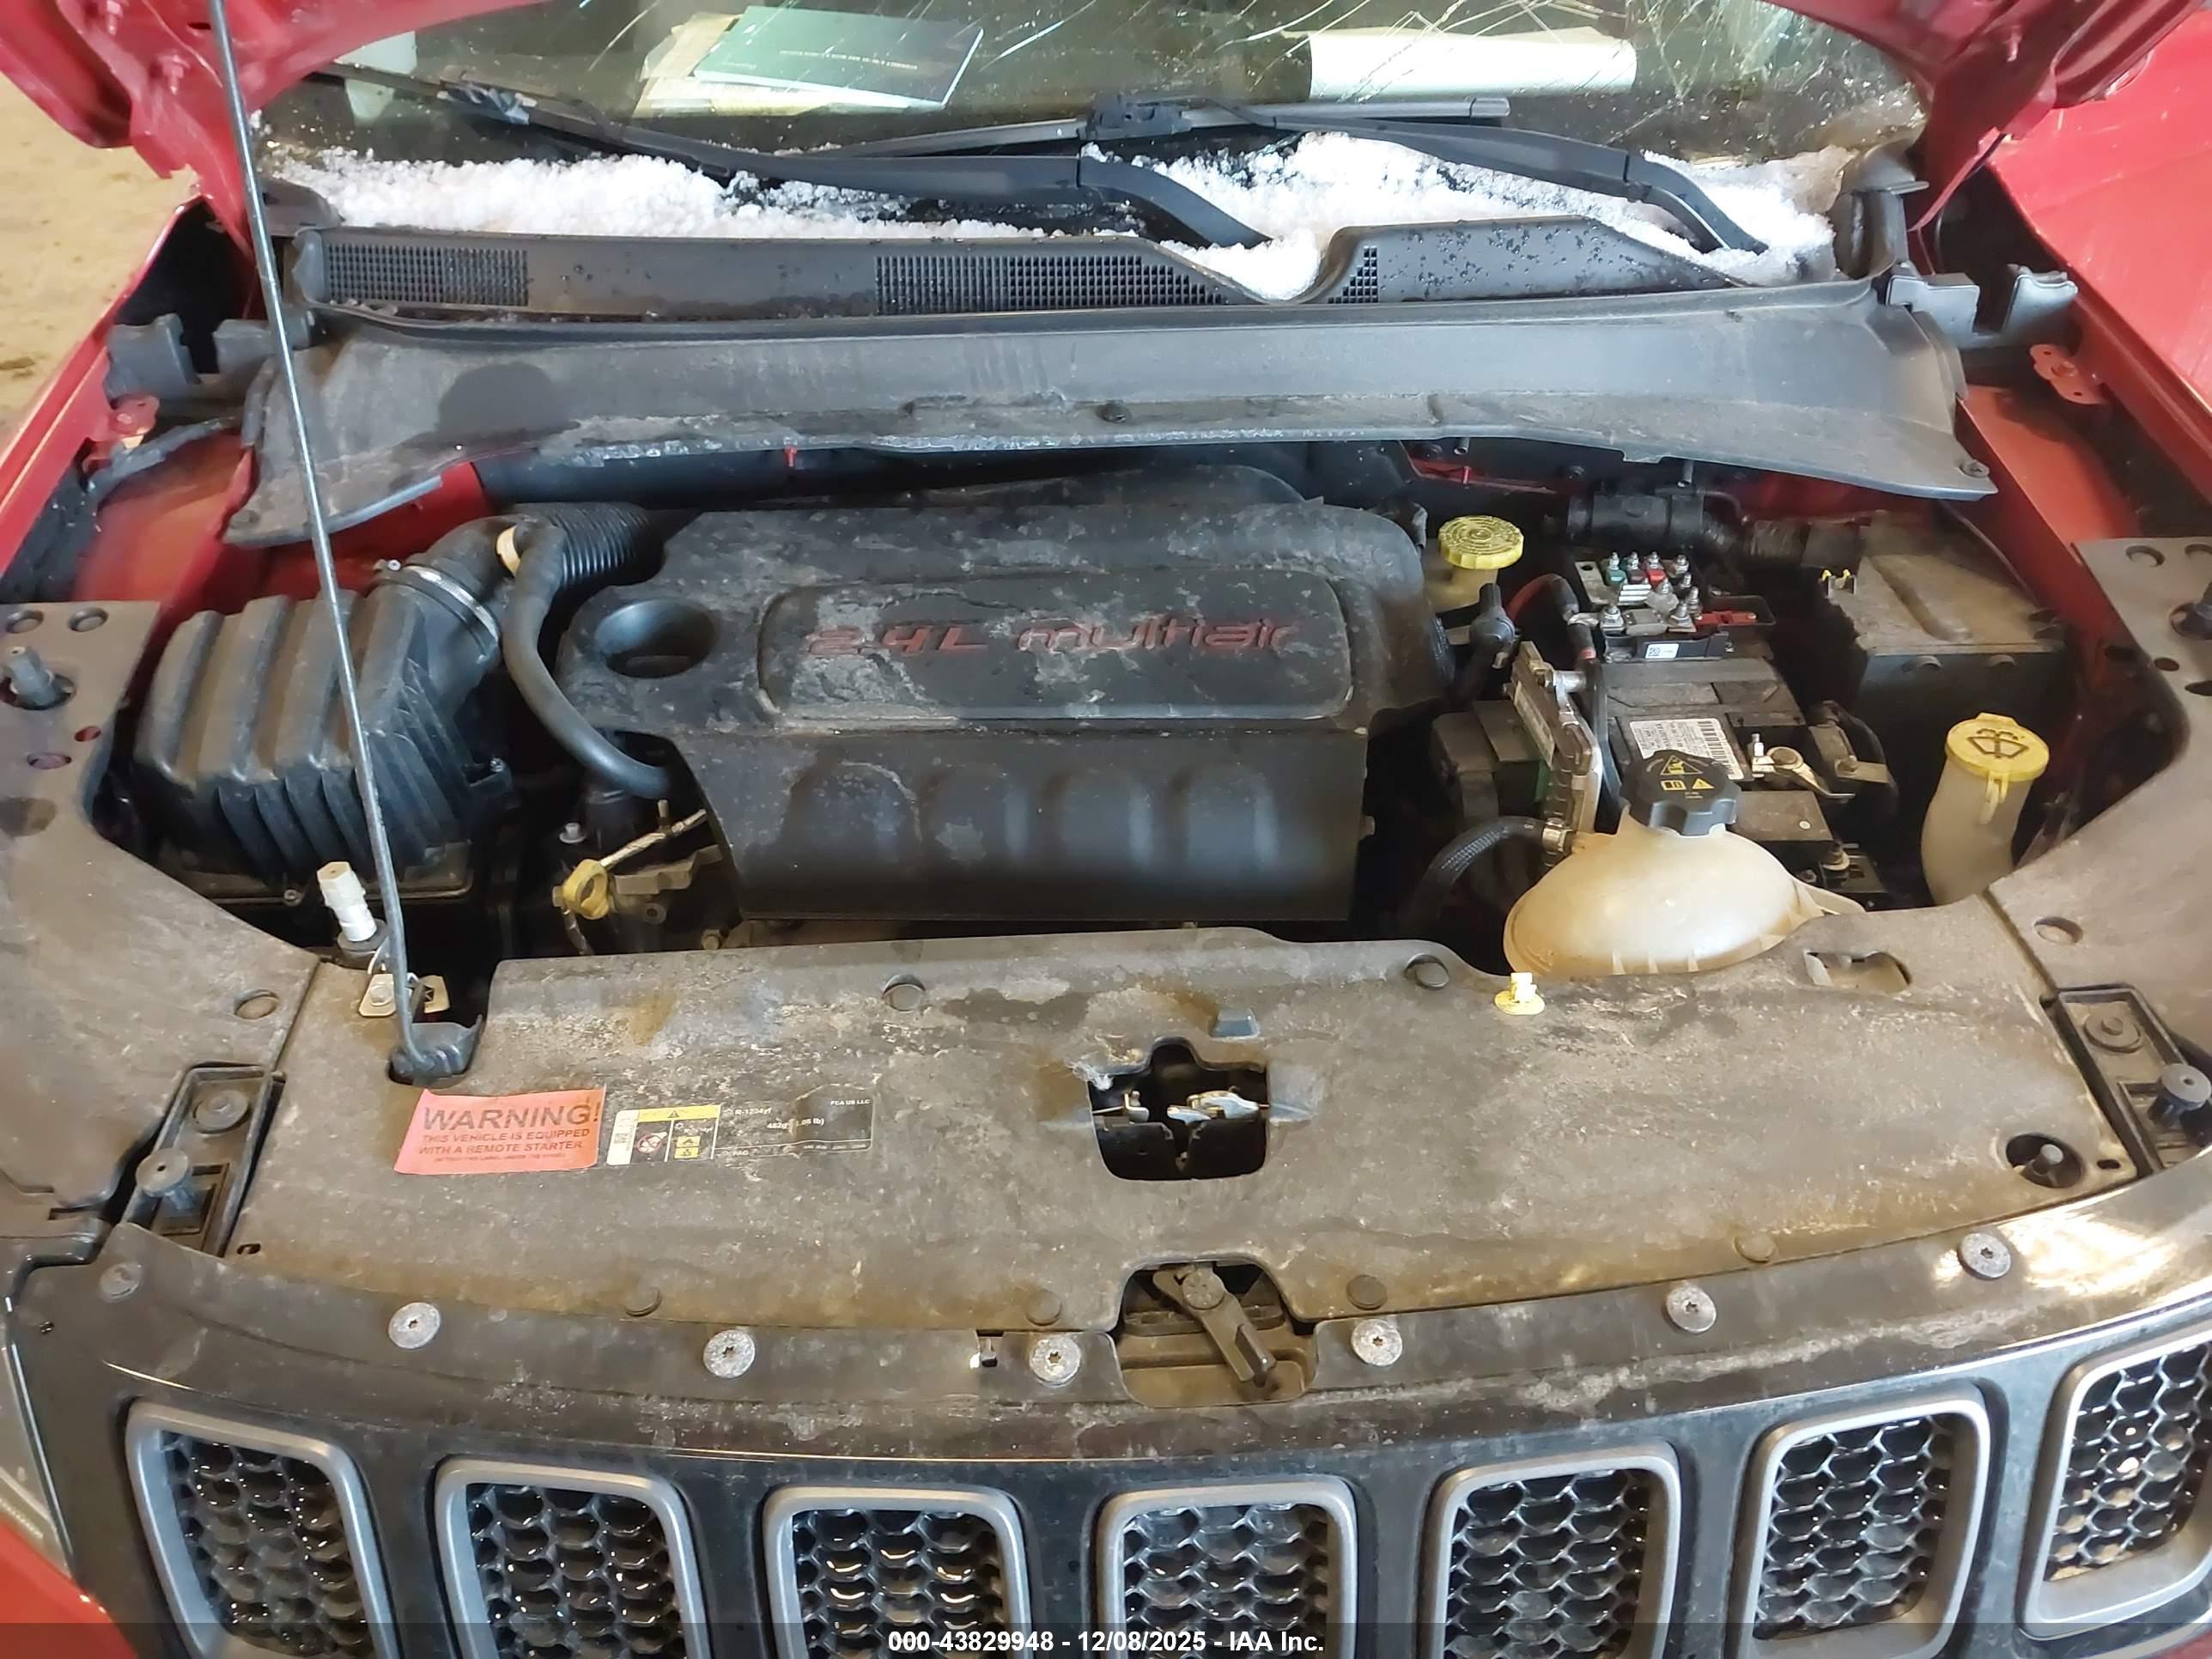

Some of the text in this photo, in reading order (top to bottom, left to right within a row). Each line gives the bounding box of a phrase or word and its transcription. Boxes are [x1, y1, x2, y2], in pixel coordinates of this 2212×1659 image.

[1017, 617, 1293, 653] multiair
[423, 1102, 600, 1130] WARNING!
[423, 1128, 591, 1143] THIS VEHICLE IS EQUIPPED
[419, 1146, 451, 1155] WITH
[451, 1145, 462, 1154] A
[466, 1143, 521, 1153] REMOTE
